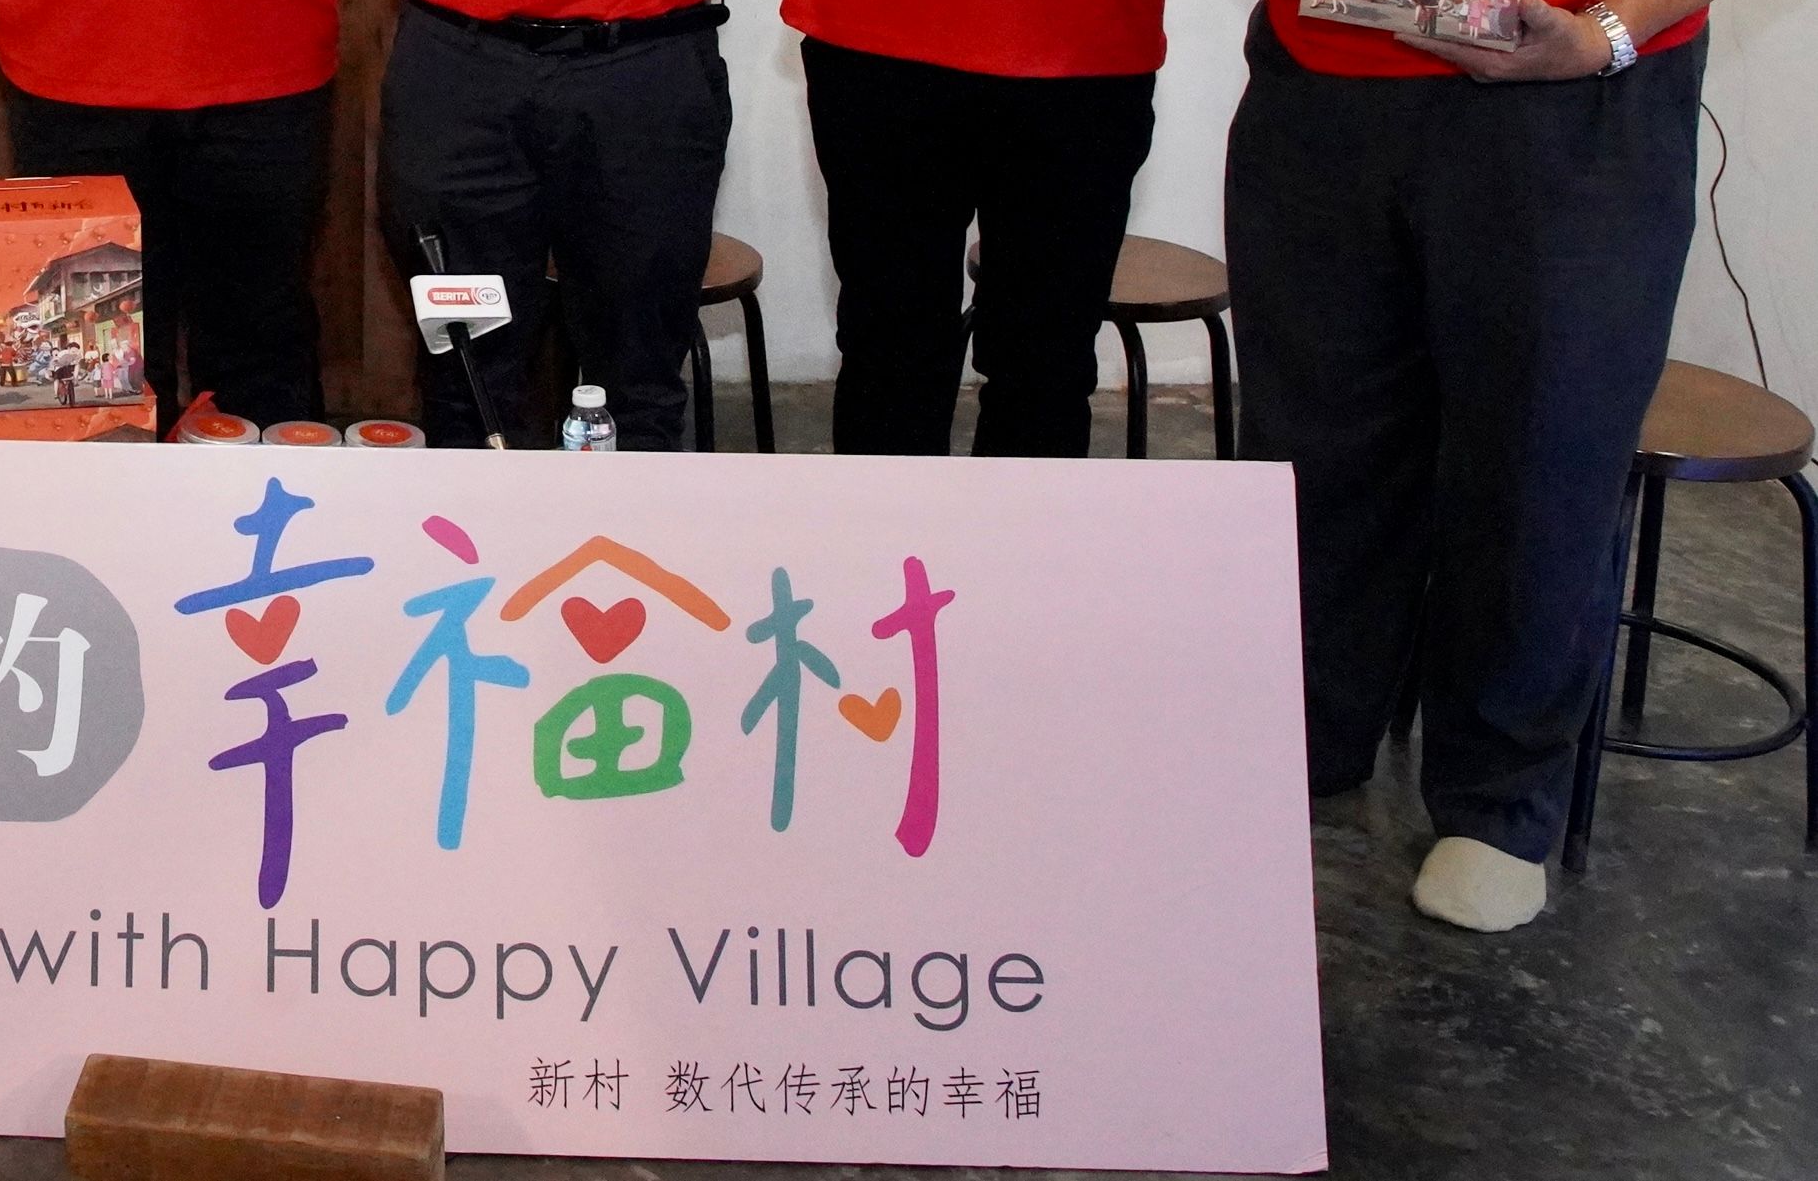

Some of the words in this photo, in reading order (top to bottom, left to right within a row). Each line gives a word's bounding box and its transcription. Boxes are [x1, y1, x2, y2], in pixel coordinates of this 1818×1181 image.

[432, 291, 470, 301] BERITA
[267, 917, 619, 1022] Happy
[667, 925, 1045, 1032] Village
[527, 1056, 630, 1111] 新村
[665, 1060, 1042, 1120] 数代传承的幸福
